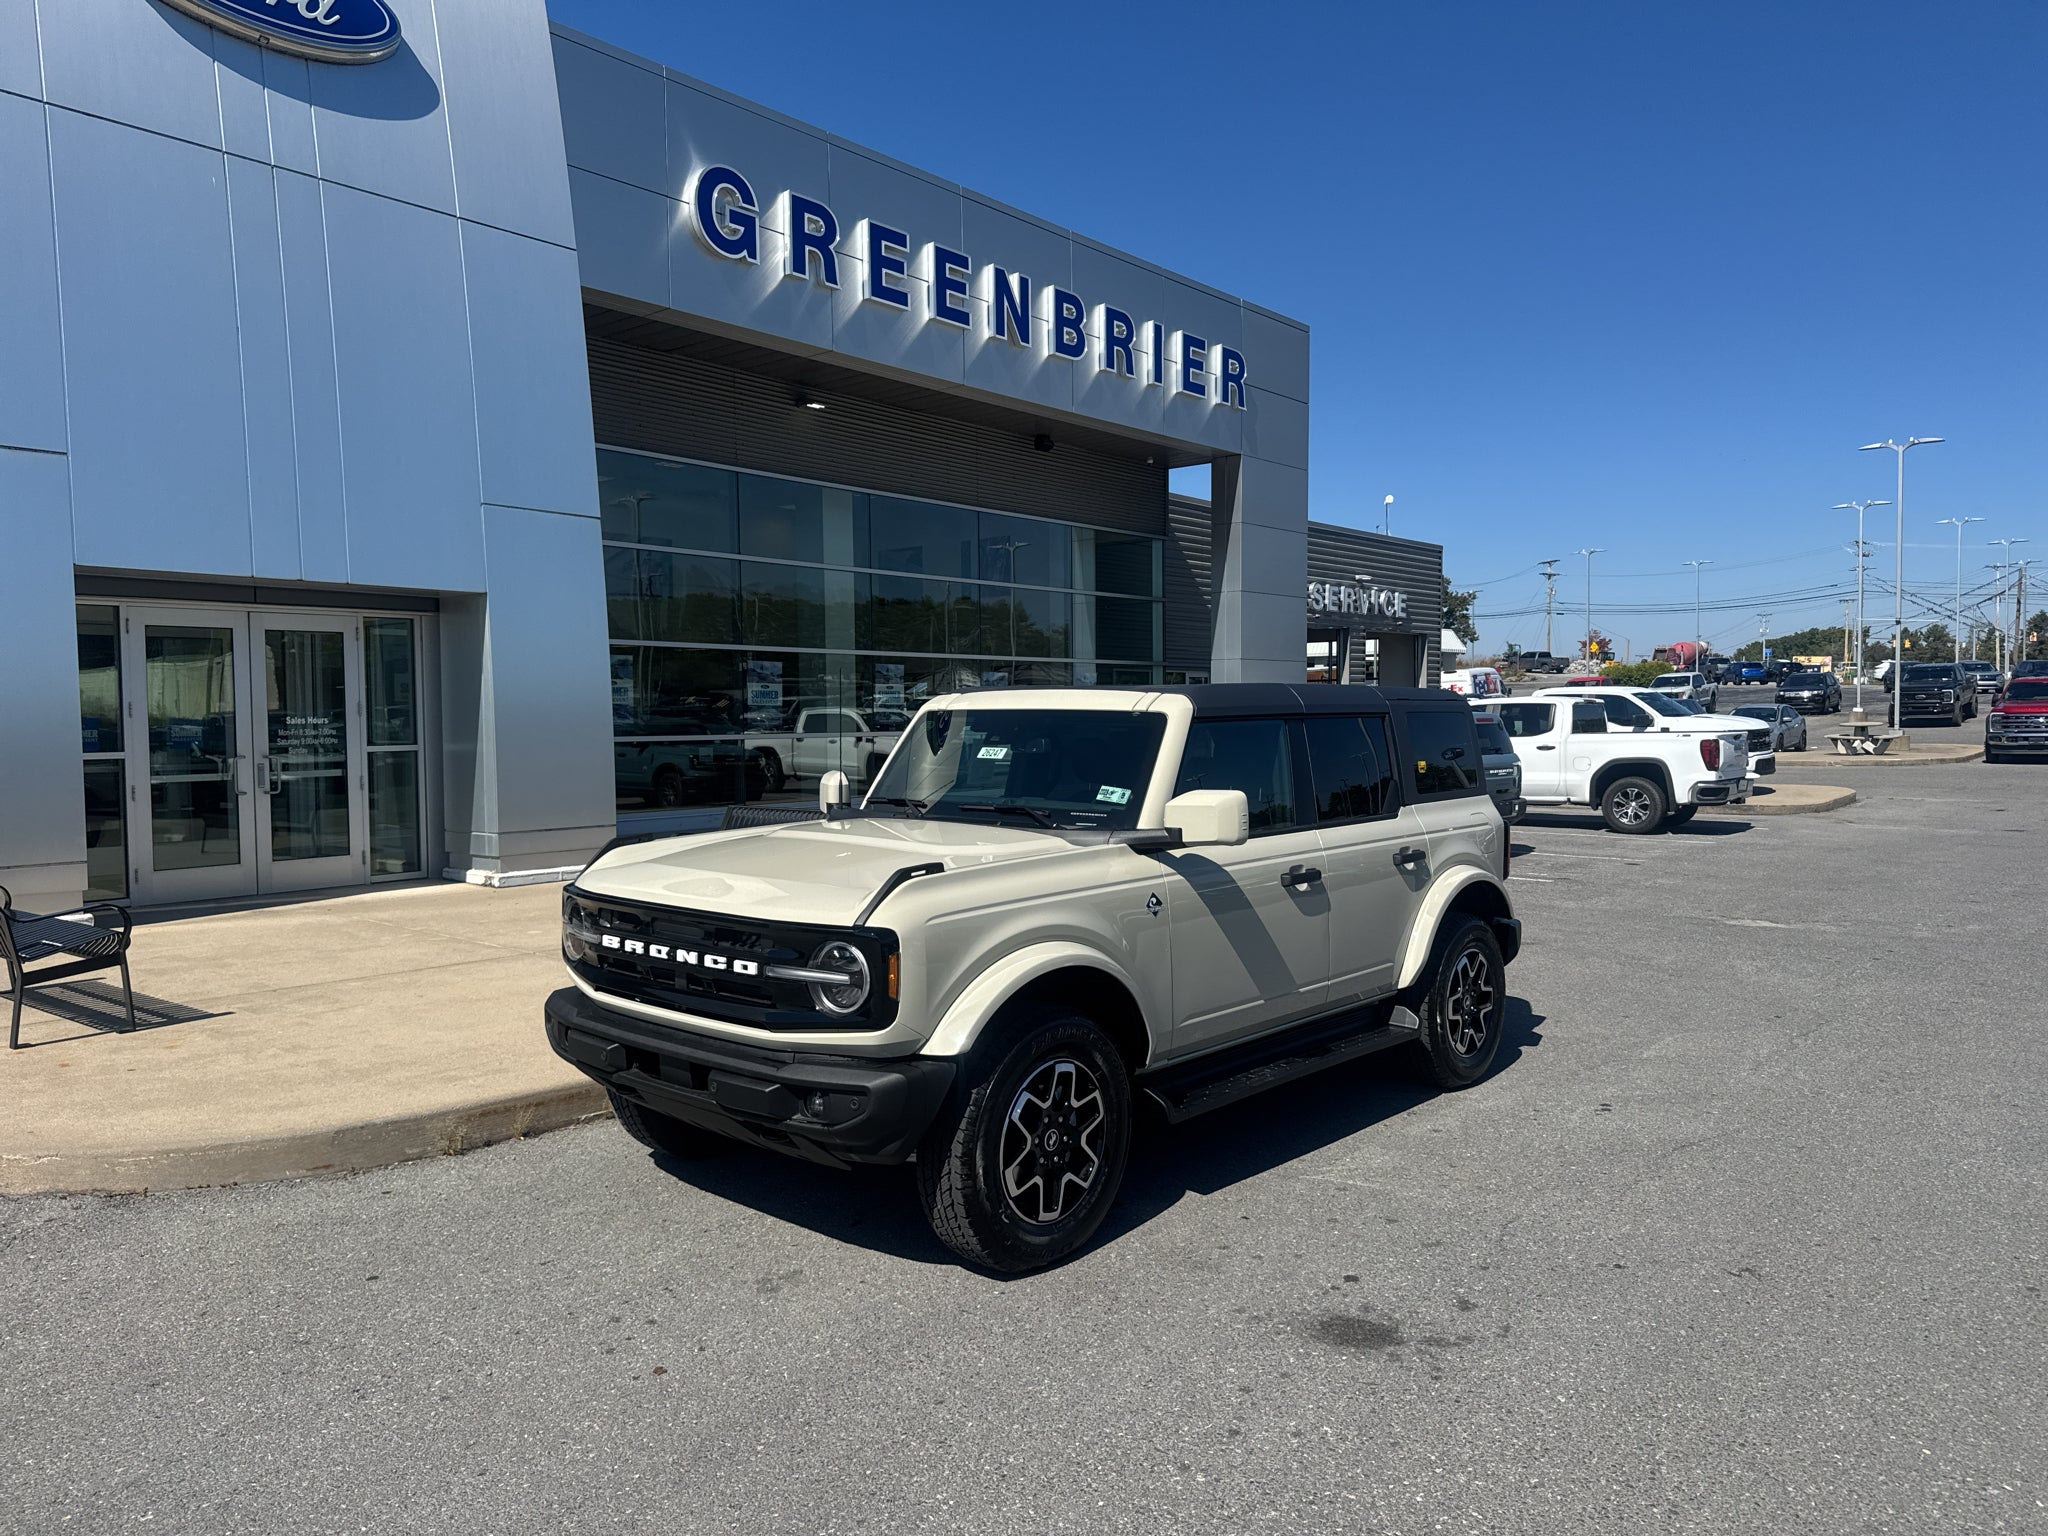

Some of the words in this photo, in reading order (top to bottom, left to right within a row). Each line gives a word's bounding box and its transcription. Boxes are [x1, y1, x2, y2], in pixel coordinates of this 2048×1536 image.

[691, 163, 1248, 410] GREENBRIER
[1307, 582, 1407, 618] SERVICE
[612, 687, 629, 697] MER
[751, 690, 779, 699] SUMMER
[286, 716, 306, 724] Sales
[307, 716, 329, 724] Hours
[278, 728, 298, 736] Mon-Fri
[276, 738, 300, 746] Saturday
[602, 934, 758, 975] BRONCO
